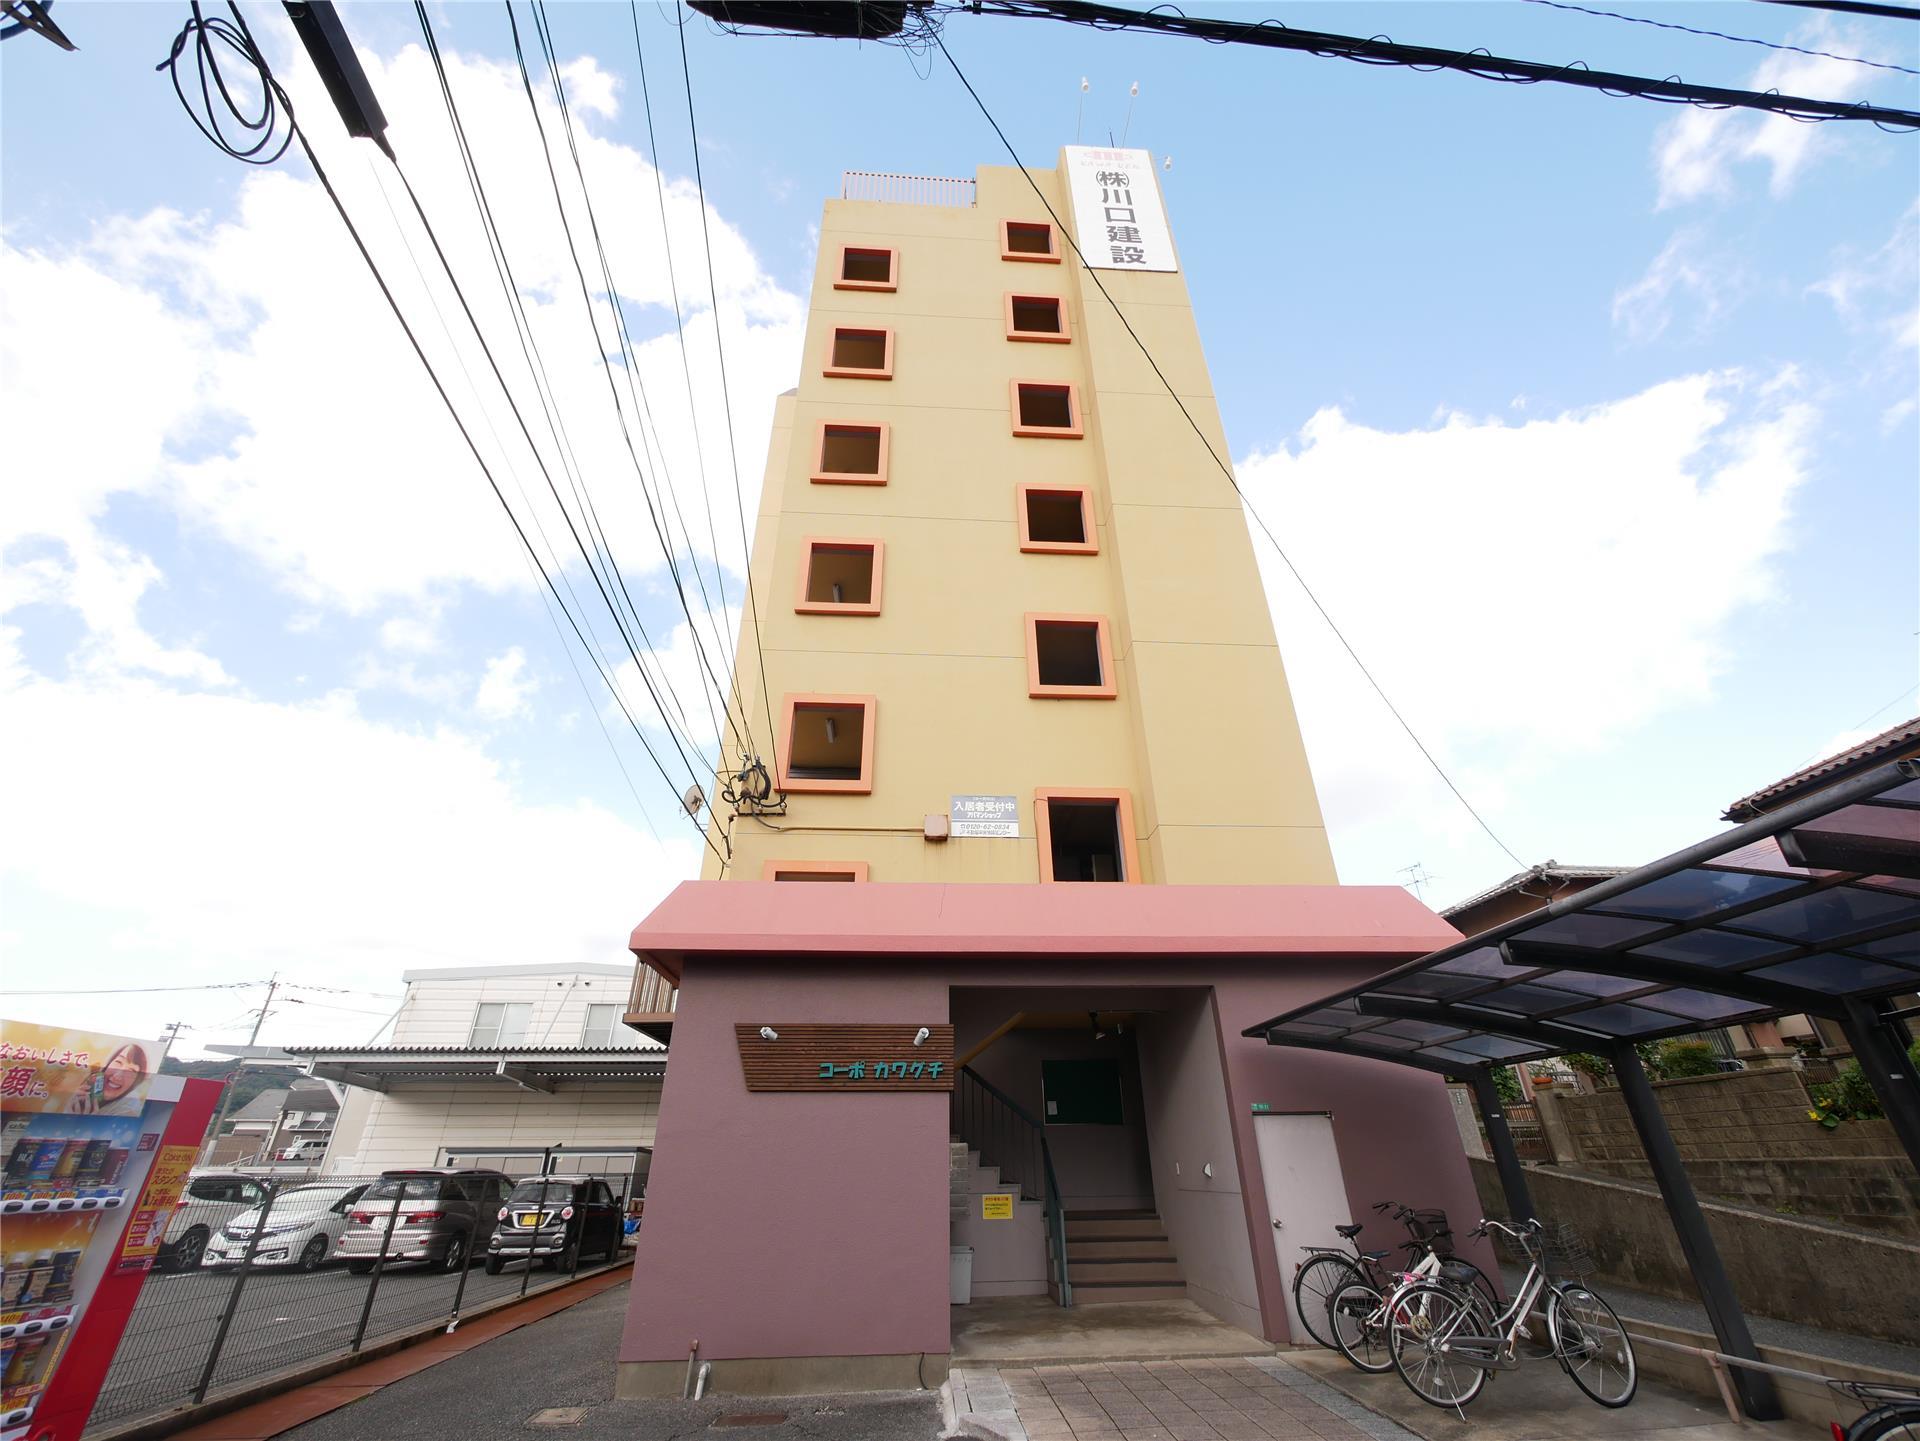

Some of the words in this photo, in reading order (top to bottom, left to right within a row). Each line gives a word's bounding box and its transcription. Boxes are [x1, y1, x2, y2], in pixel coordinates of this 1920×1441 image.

[954, 801, 1015, 812] 入居者受付中
[818, 1061, 866, 1079] コーポ
[873, 1061, 944, 1079] カワグチ
[0, 1066, 48, 1098] 顔に。
